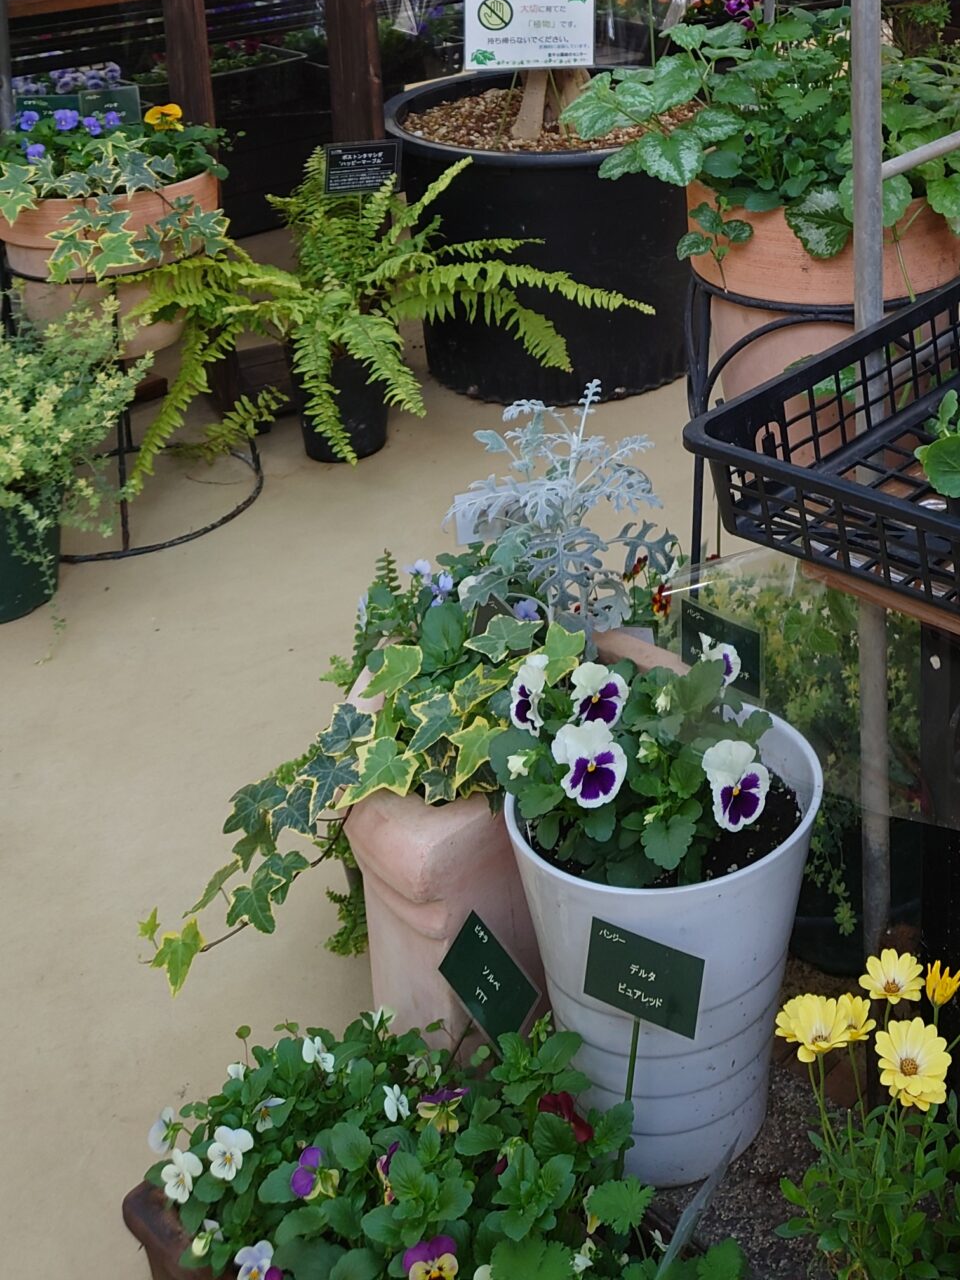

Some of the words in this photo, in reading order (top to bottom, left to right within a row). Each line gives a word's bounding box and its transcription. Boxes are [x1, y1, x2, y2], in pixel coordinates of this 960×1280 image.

[473, 923, 489, 943] ビオラ
[598, 927, 626, 945] パンジー
[629, 963, 657, 982] デルタ
[617, 981, 664, 1008] ピュアレッド
